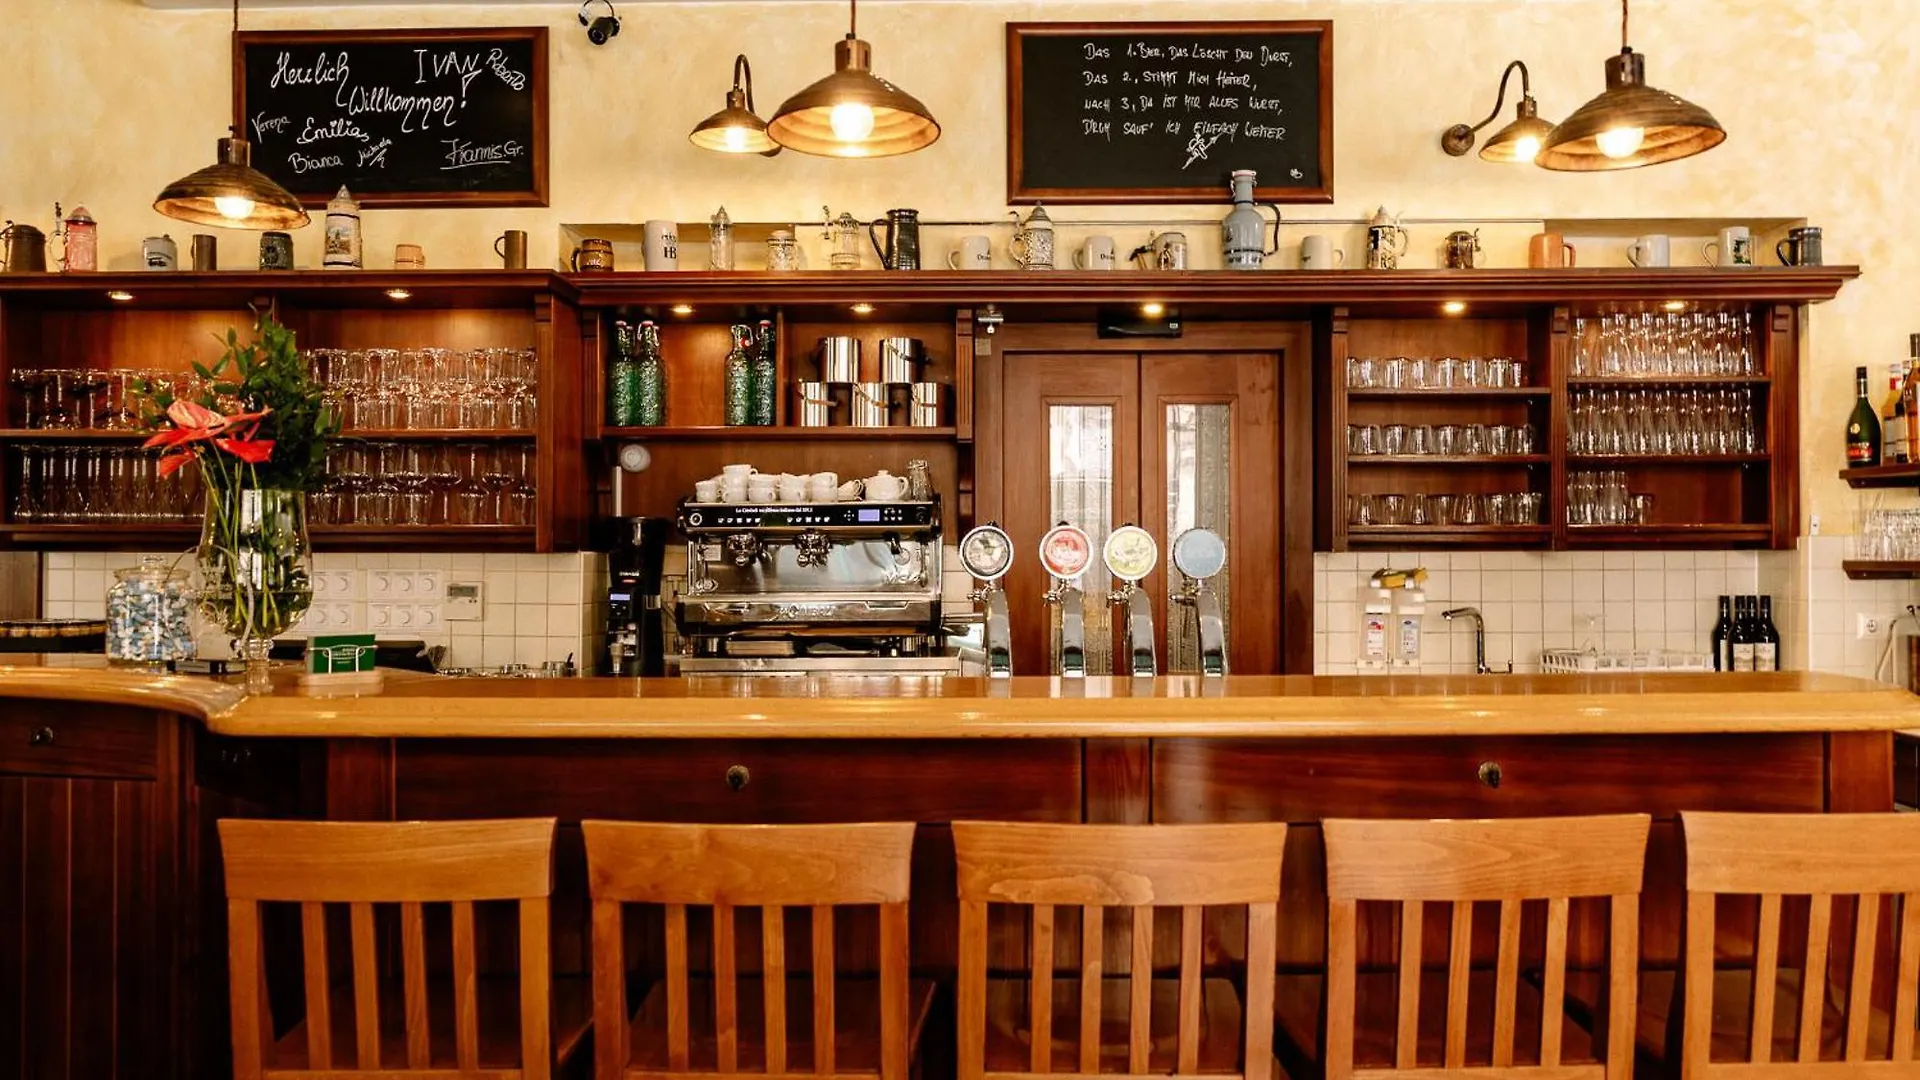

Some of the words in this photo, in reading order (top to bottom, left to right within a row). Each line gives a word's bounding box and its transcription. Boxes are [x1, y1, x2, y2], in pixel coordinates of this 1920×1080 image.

[270, 51, 350, 107] Herzlich
[413, 48, 480, 84] IVAN
[251, 111, 291, 144] Verena
[287, 152, 344, 174] Bianca
